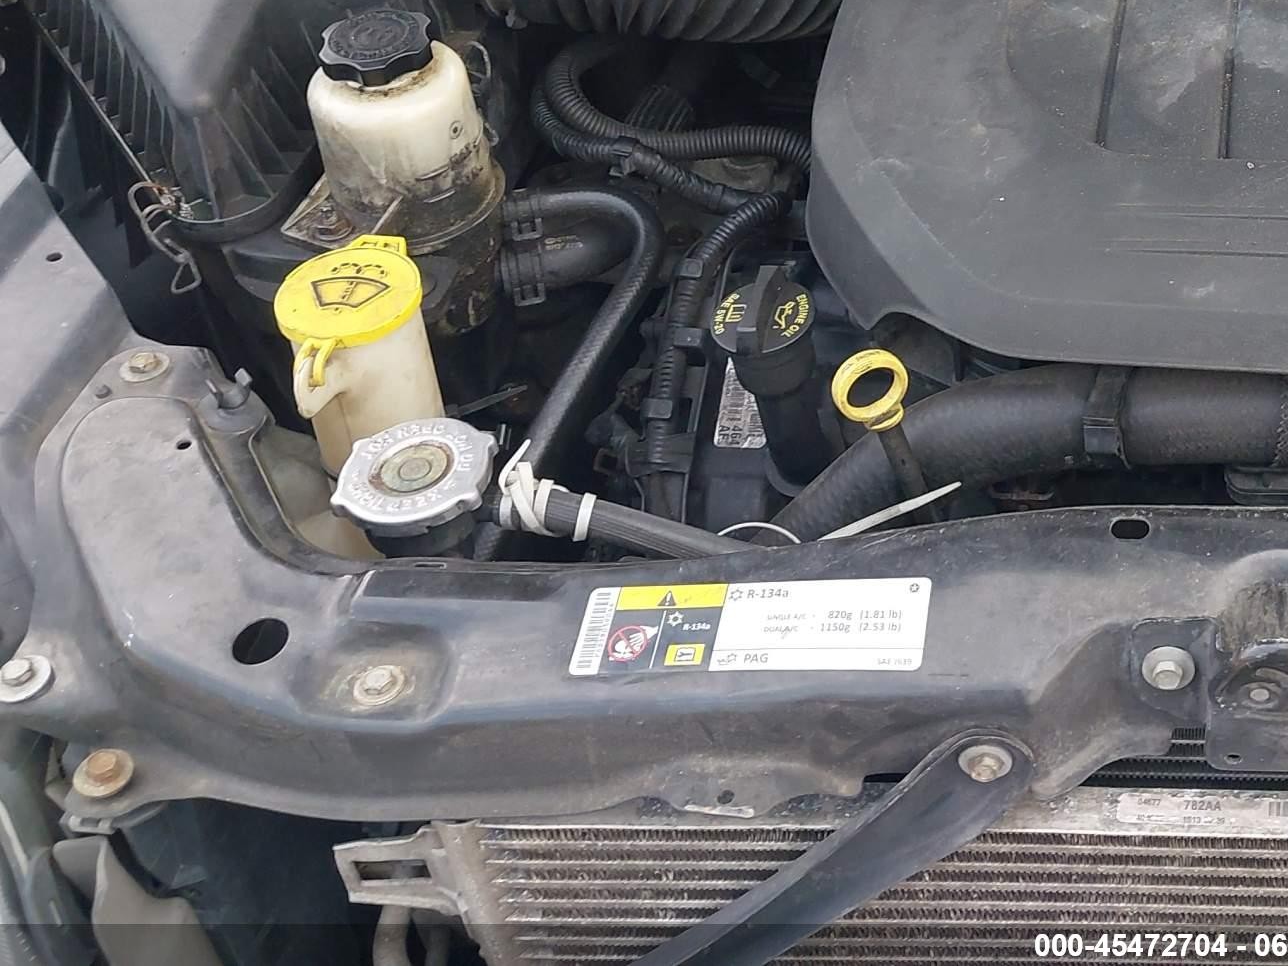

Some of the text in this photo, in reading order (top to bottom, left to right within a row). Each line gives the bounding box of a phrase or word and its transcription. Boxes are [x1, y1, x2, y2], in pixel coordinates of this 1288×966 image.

[713, 293, 740, 335] SAE 5W-20
[781, 294, 809, 337] ENGINE OIL
[746, 588, 789, 599] R-134a
[827, 610, 853, 621] 820g
[859, 610, 885, 620] (1.81
[683, 623, 711, 631] R-134a
[820, 623, 851, 633] 1150g
[859, 623, 885, 633] (2.53
[743, 653, 769, 664] PAG
[1184, 799, 1221, 810] 782AA
